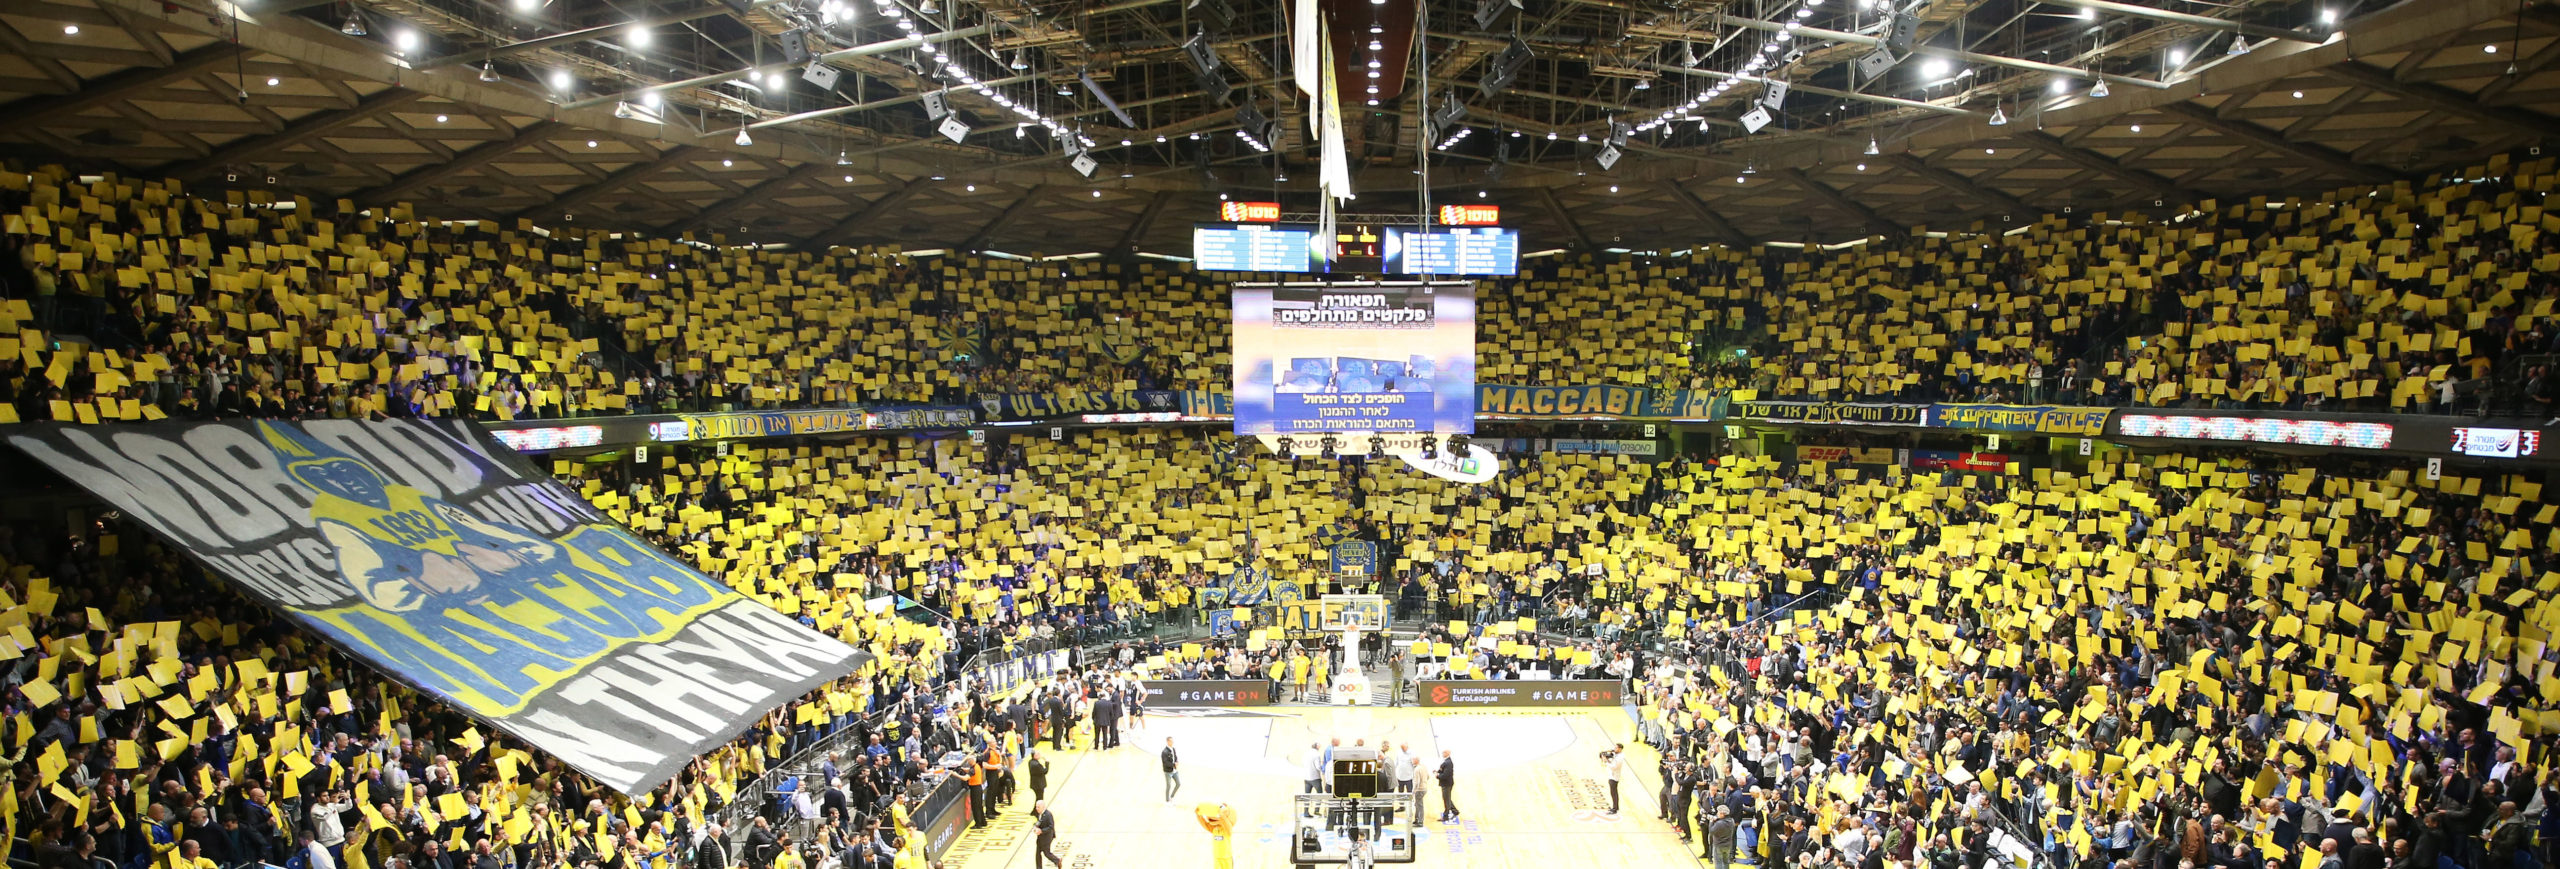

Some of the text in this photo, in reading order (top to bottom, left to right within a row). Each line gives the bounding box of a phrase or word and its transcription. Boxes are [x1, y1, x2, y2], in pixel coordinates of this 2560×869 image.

[1247, 206, 1279, 219] טוטו
[1466, 209, 1498, 222] טוטו
[1322, 294, 1386, 307] תפאורת
[1281, 307, 1426, 325] פלקטים מתחלפים
[1010, 390, 1107, 418] ULTRAS
[1110, 391, 1141, 411] 96
[1303, 393, 1405, 404] הופכים לצד הכחול
[1481, 387, 1643, 416] MACCABI
[1318, 405, 1390, 418] לאחר ההמנון
[1293, 418, 1415, 429] בהתאם להוראות הכרוז
[1961, 407, 2040, 429] SUPPORTERS
[2045, 412, 2073, 431] FOR
[2076, 411, 2106, 432] LIFE
[650, 424, 659, 440] 9
[974, 431, 984, 441] 10
[1053, 429, 1060, 438] 11
[1646, 426, 1654, 436] 12
[2083, 441, 2089, 452] 2
[2451, 429, 2464, 452] 2
[2520, 432, 2534, 456] 3
[637, 450, 645, 460] 9
[717, 444, 727, 454] 10
[2430, 462, 2438, 477] 2
[9, 419, 522, 549] NOBODY
[470, 481, 600, 534] WITH
[375, 507, 448, 549] 1932
[298, 526, 735, 707] MACCABI
[1279, 603, 1344, 630] ATE
[556, 641, 775, 745] THE
[1452, 694, 1498, 704] EuroLeague
[1348, 762, 1376, 774] 1:17
